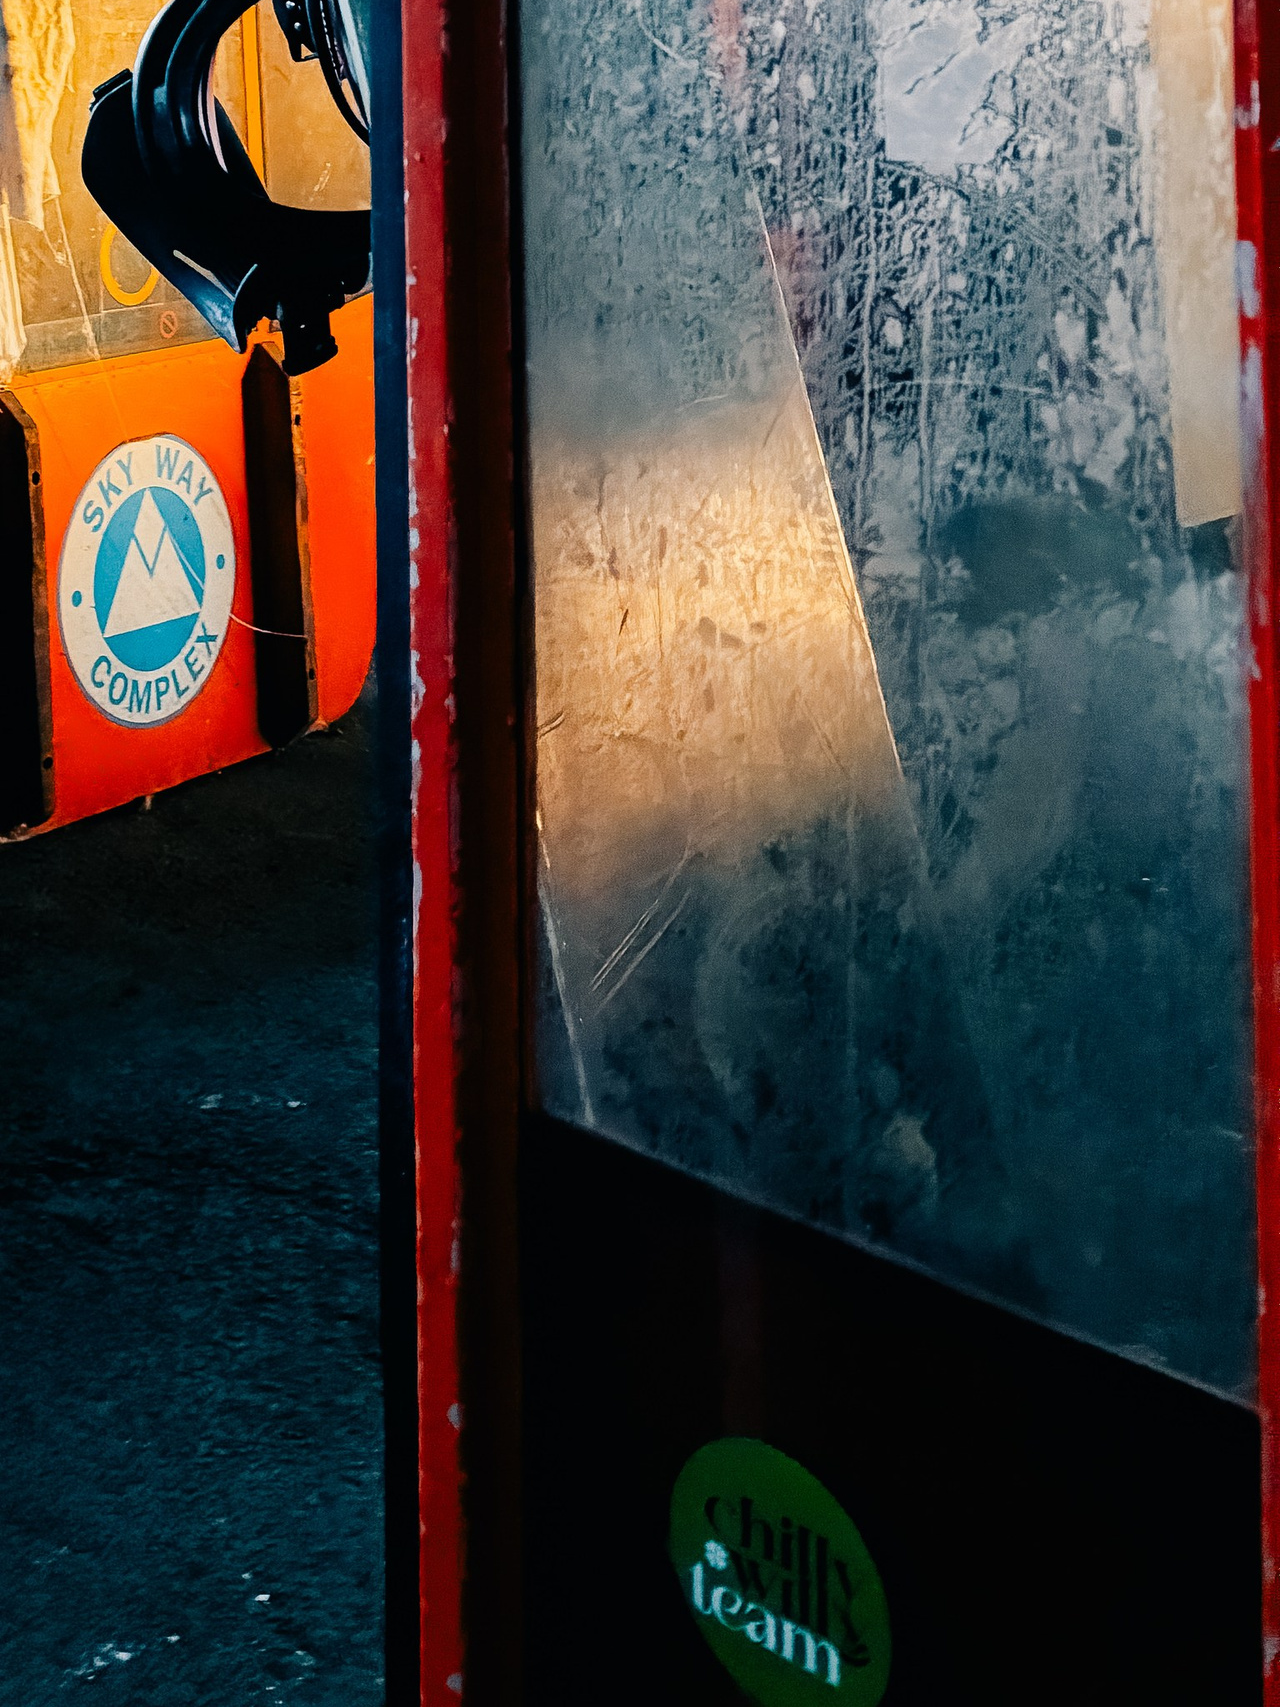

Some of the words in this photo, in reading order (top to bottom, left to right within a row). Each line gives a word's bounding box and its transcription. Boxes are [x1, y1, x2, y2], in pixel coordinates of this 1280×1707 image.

[81, 451, 134, 533] SKY
[155, 444, 214, 508] WAY
[91, 622, 218, 715] COMPLEX
[692, 1560, 841, 1687] team
